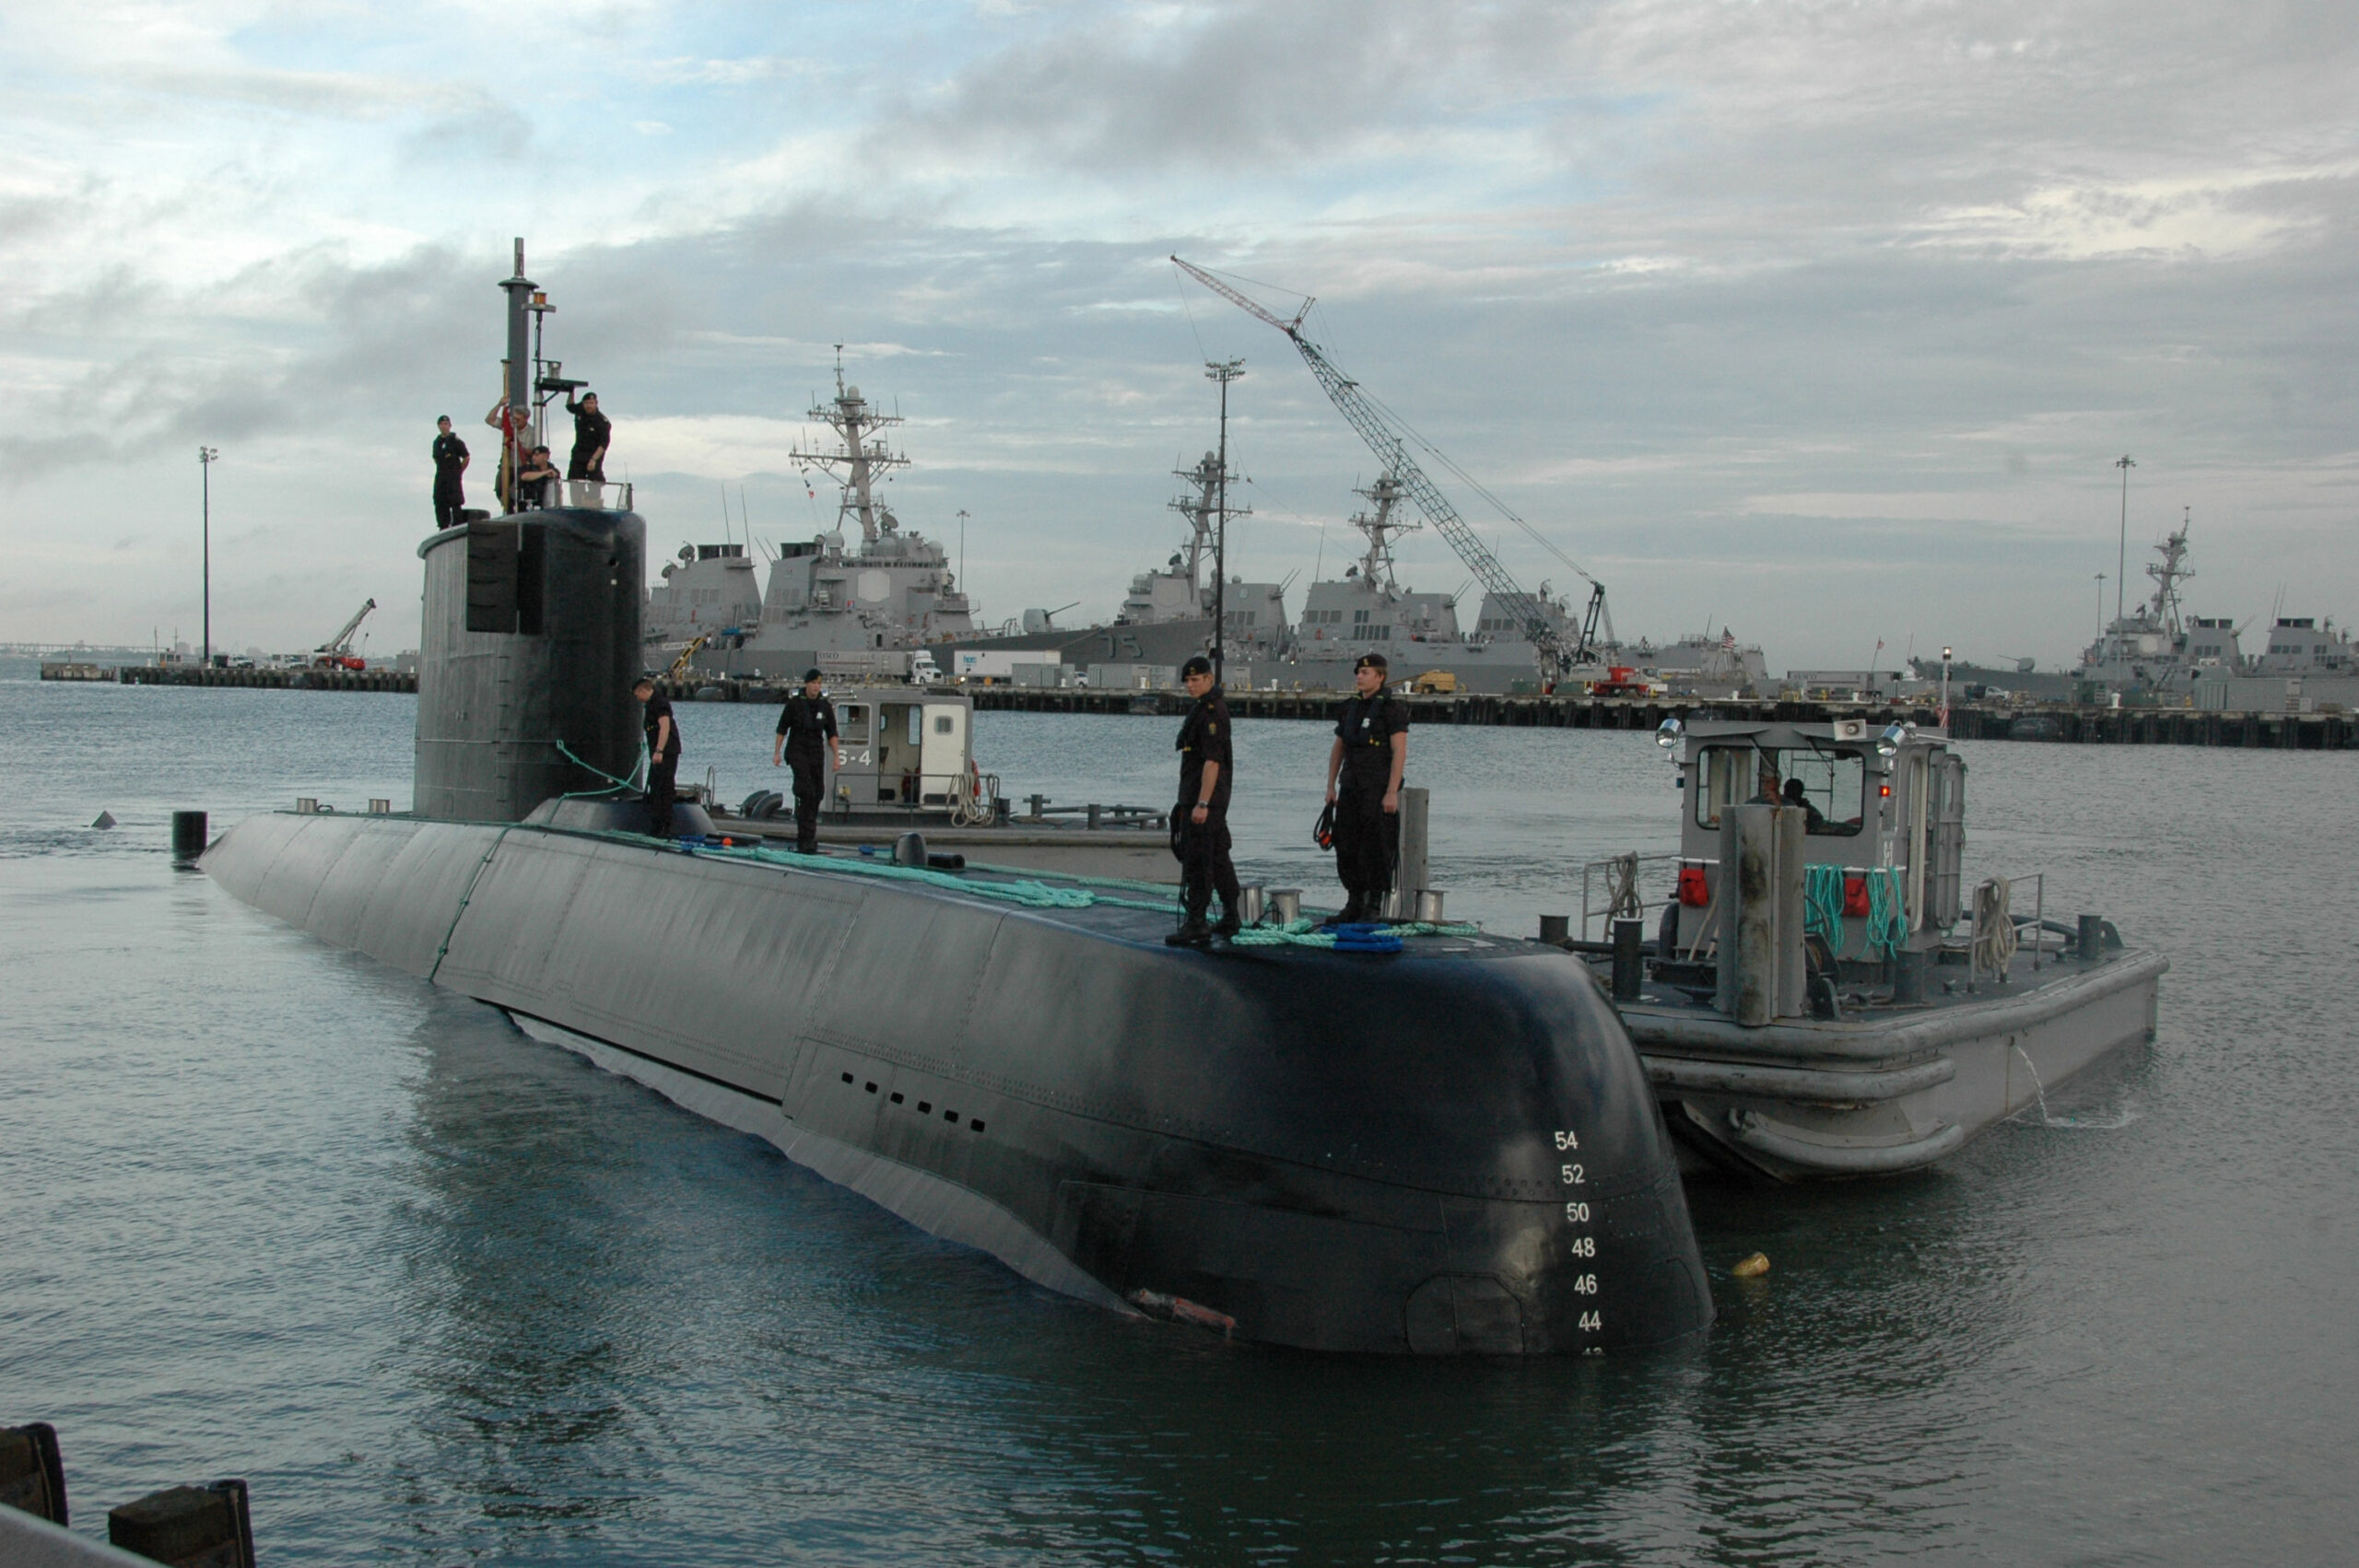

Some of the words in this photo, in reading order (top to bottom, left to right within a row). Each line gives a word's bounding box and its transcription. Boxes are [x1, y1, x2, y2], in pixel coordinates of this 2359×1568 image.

[1098, 633, 1144, 659] 75
[1555, 1131, 1579, 1151] 54
[1562, 1164, 1585, 1184] 52
[1567, 1202, 1590, 1223] 50
[1571, 1237, 1596, 1258] 48
[1574, 1274, 1597, 1294] 46
[1579, 1310, 1602, 1331] 44
